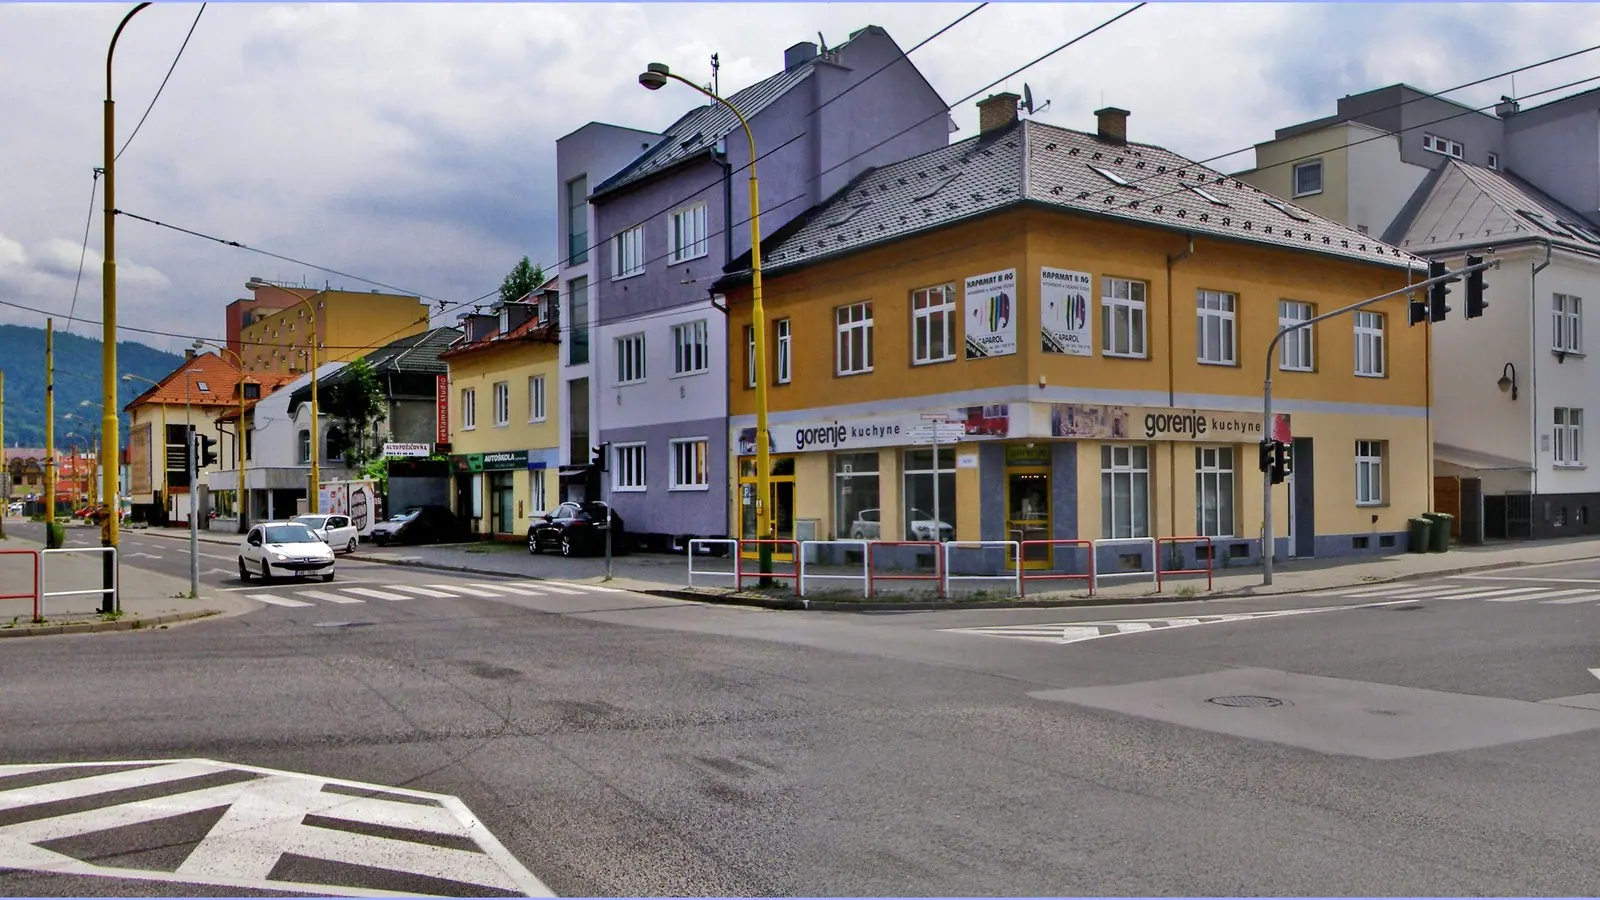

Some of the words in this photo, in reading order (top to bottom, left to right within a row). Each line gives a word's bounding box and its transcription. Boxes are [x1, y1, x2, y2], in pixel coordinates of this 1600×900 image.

[1004, 272, 1014, 281] AG
[1080, 276, 1089, 284] AG
[1144, 409, 1206, 439] gorenje
[1212, 418, 1261, 433] kuchyne
[796, 420, 847, 449] gorenje
[851, 423, 901, 438] kuchyne
[484, 453, 515, 463] AUTOŠKOLA
